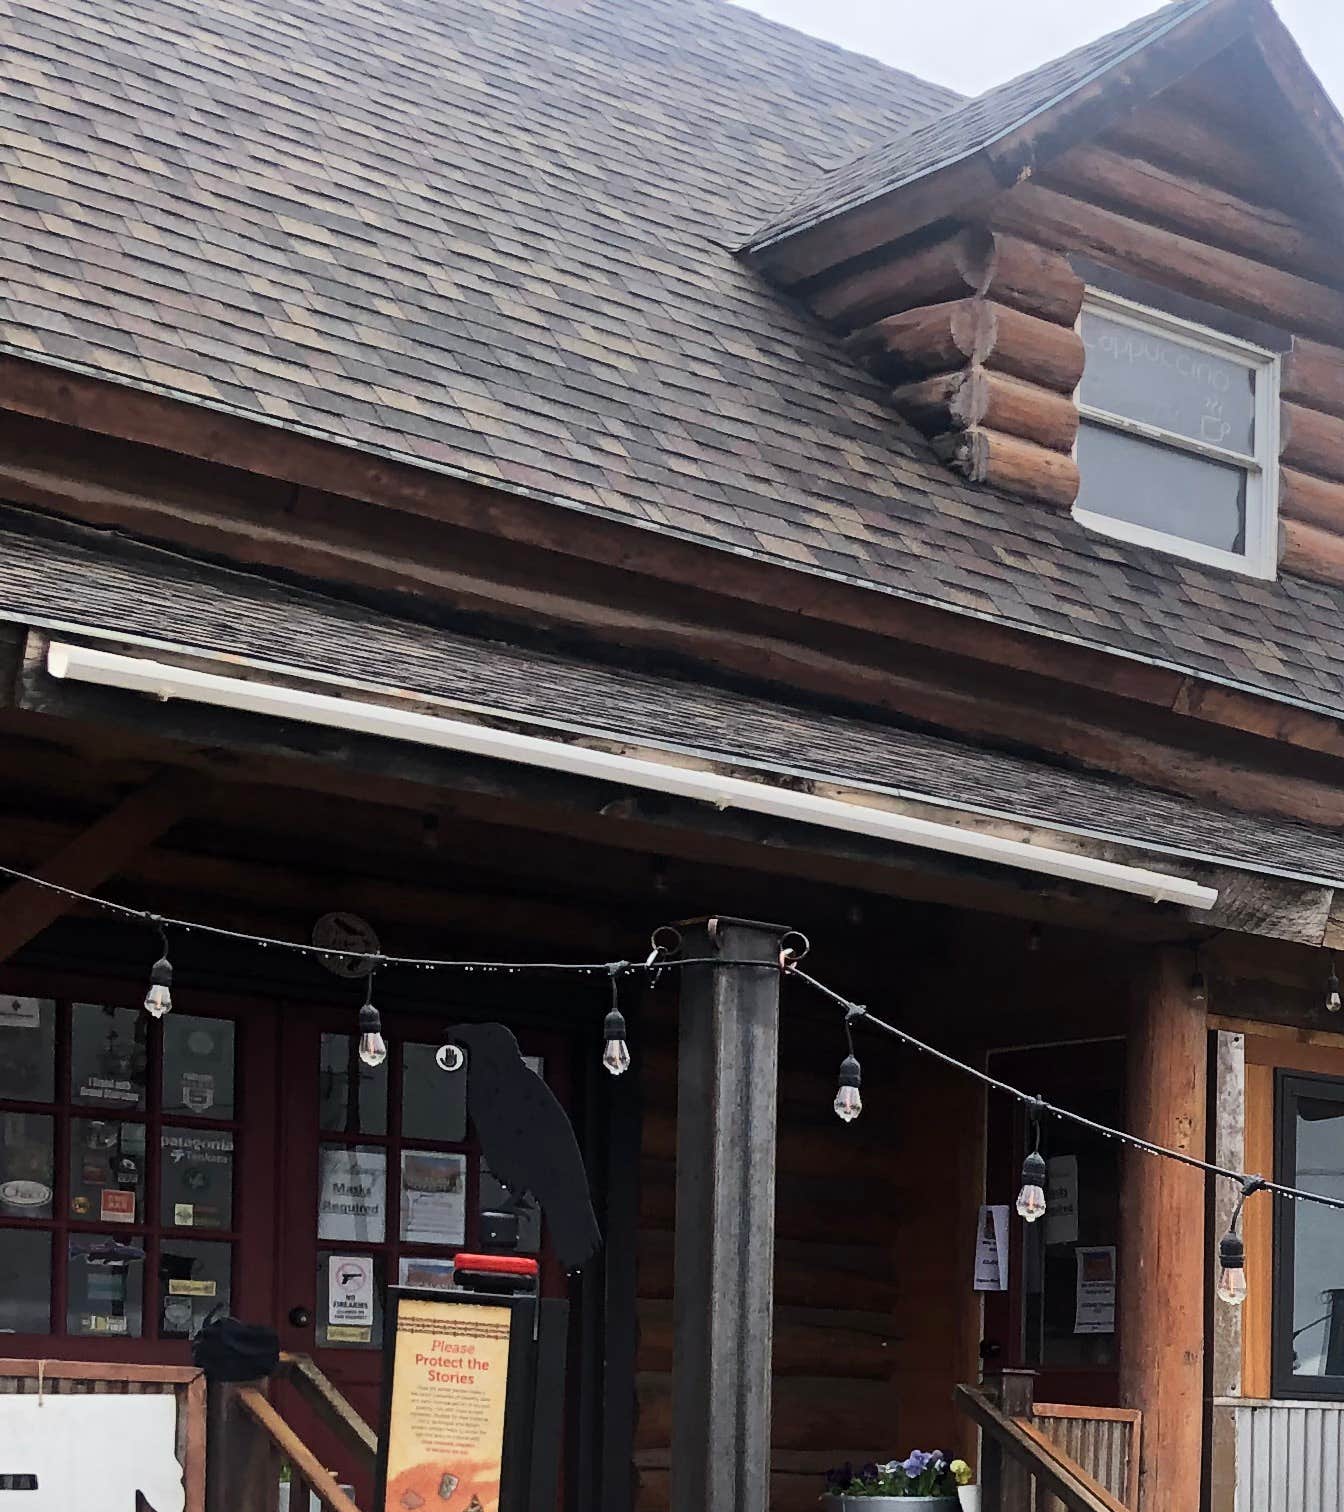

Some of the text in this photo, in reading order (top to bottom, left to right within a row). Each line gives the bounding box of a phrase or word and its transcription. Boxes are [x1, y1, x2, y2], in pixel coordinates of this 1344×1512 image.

[161, 1136, 234, 1152] patagonia
[332, 1183, 371, 1198] Masks
[321, 1200, 379, 1216] Required
[431, 1339, 475, 1354] Please
[415, 1353, 489, 1371] Protect the
[428, 1369, 475, 1385] Stories
